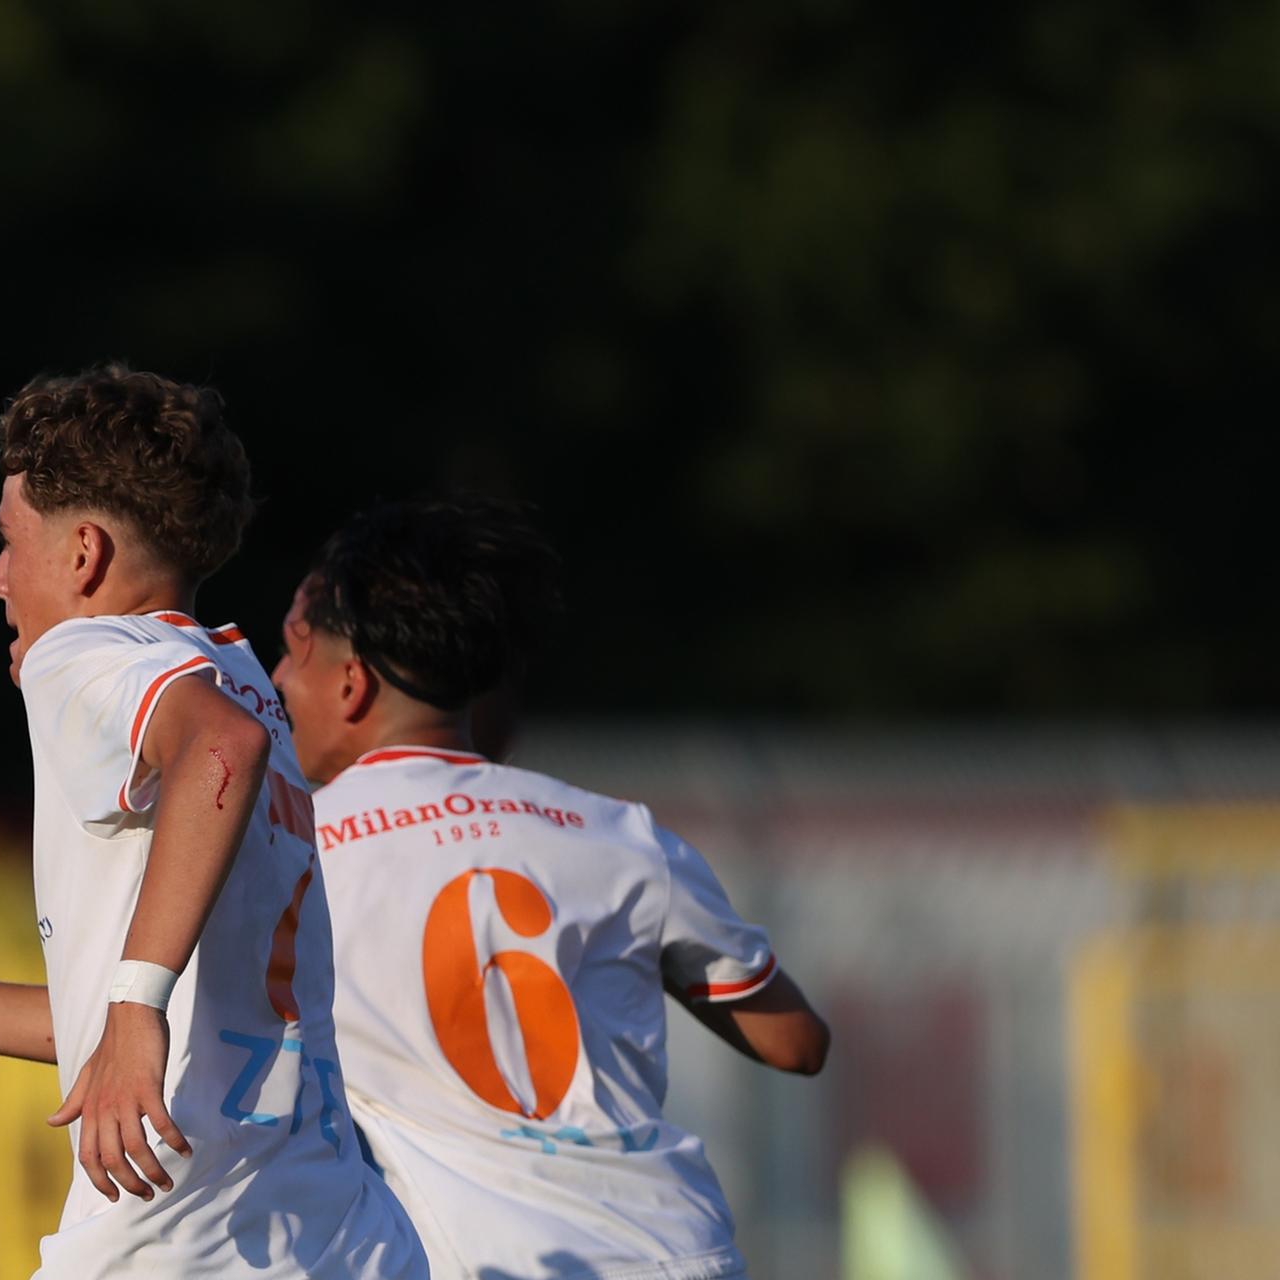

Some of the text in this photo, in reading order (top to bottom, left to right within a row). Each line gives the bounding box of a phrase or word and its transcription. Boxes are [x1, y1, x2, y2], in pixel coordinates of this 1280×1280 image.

[316, 793, 584, 851] MilanOrange
[434, 821, 501, 846] 1952
[422, 867, 580, 1121] 6
